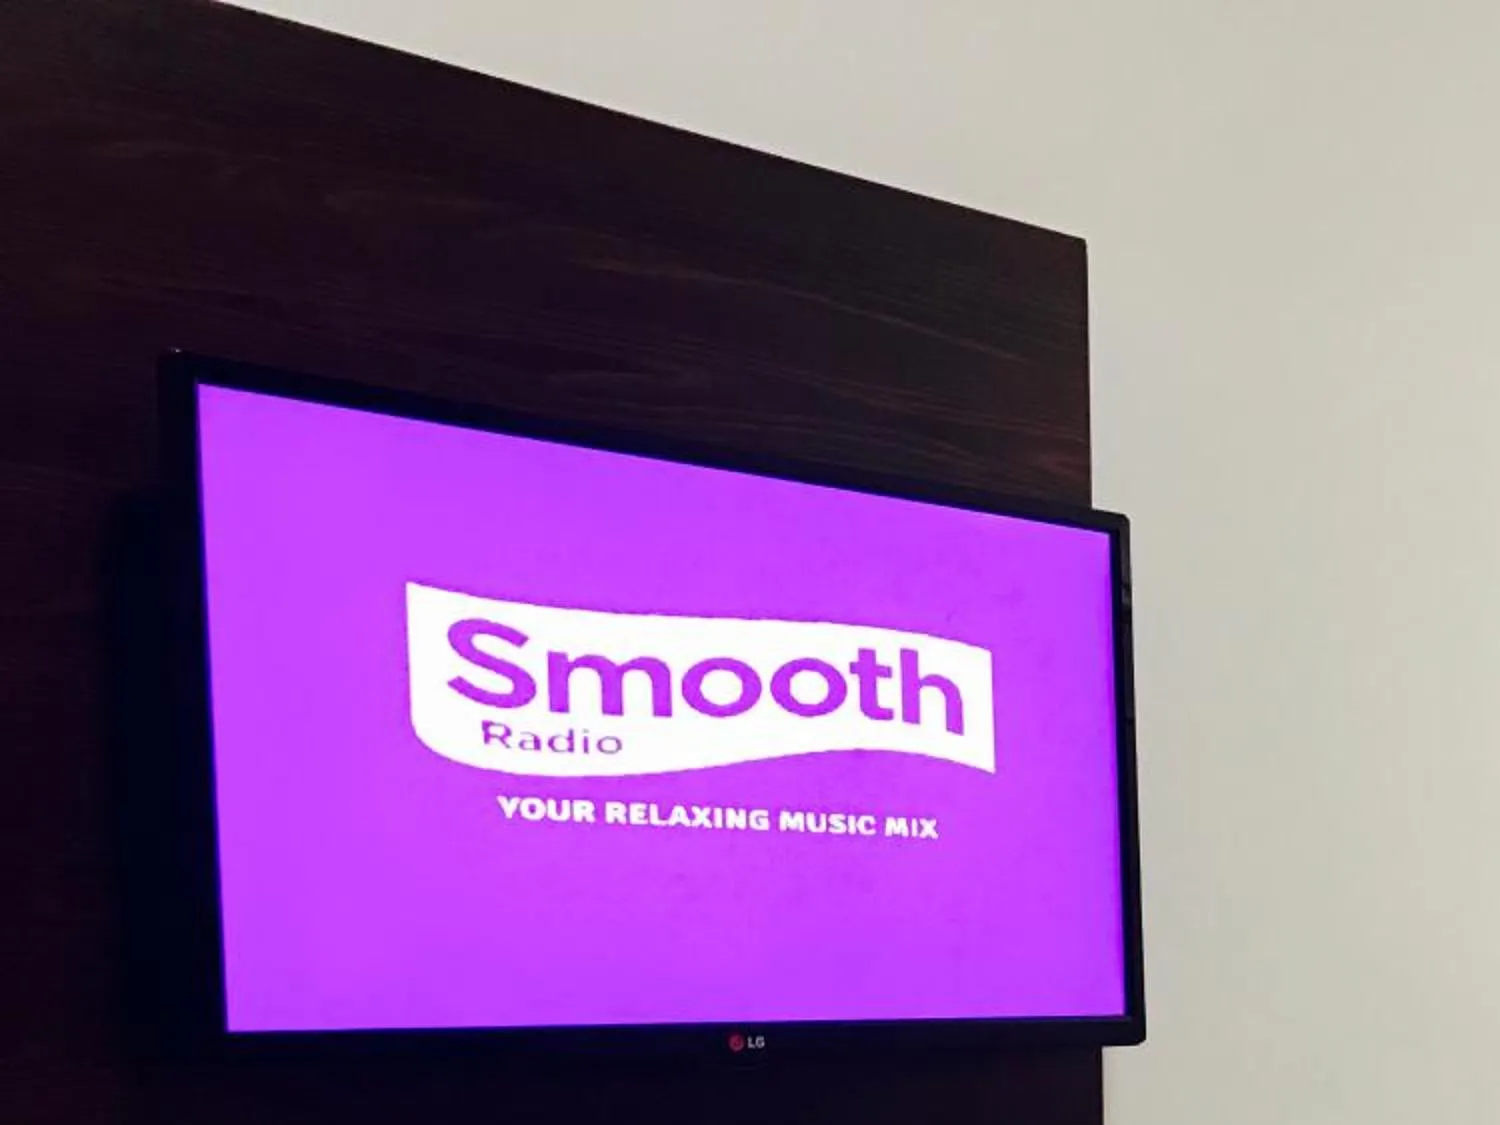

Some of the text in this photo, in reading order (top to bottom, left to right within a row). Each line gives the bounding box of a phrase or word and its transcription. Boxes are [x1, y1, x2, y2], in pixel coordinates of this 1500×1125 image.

[446, 617, 965, 736] Smooth
[480, 719, 624, 756] Radio
[496, 795, 939, 840] YOUR RELAXING MUSIC MIX
[747, 1035, 766, 1049] LG
